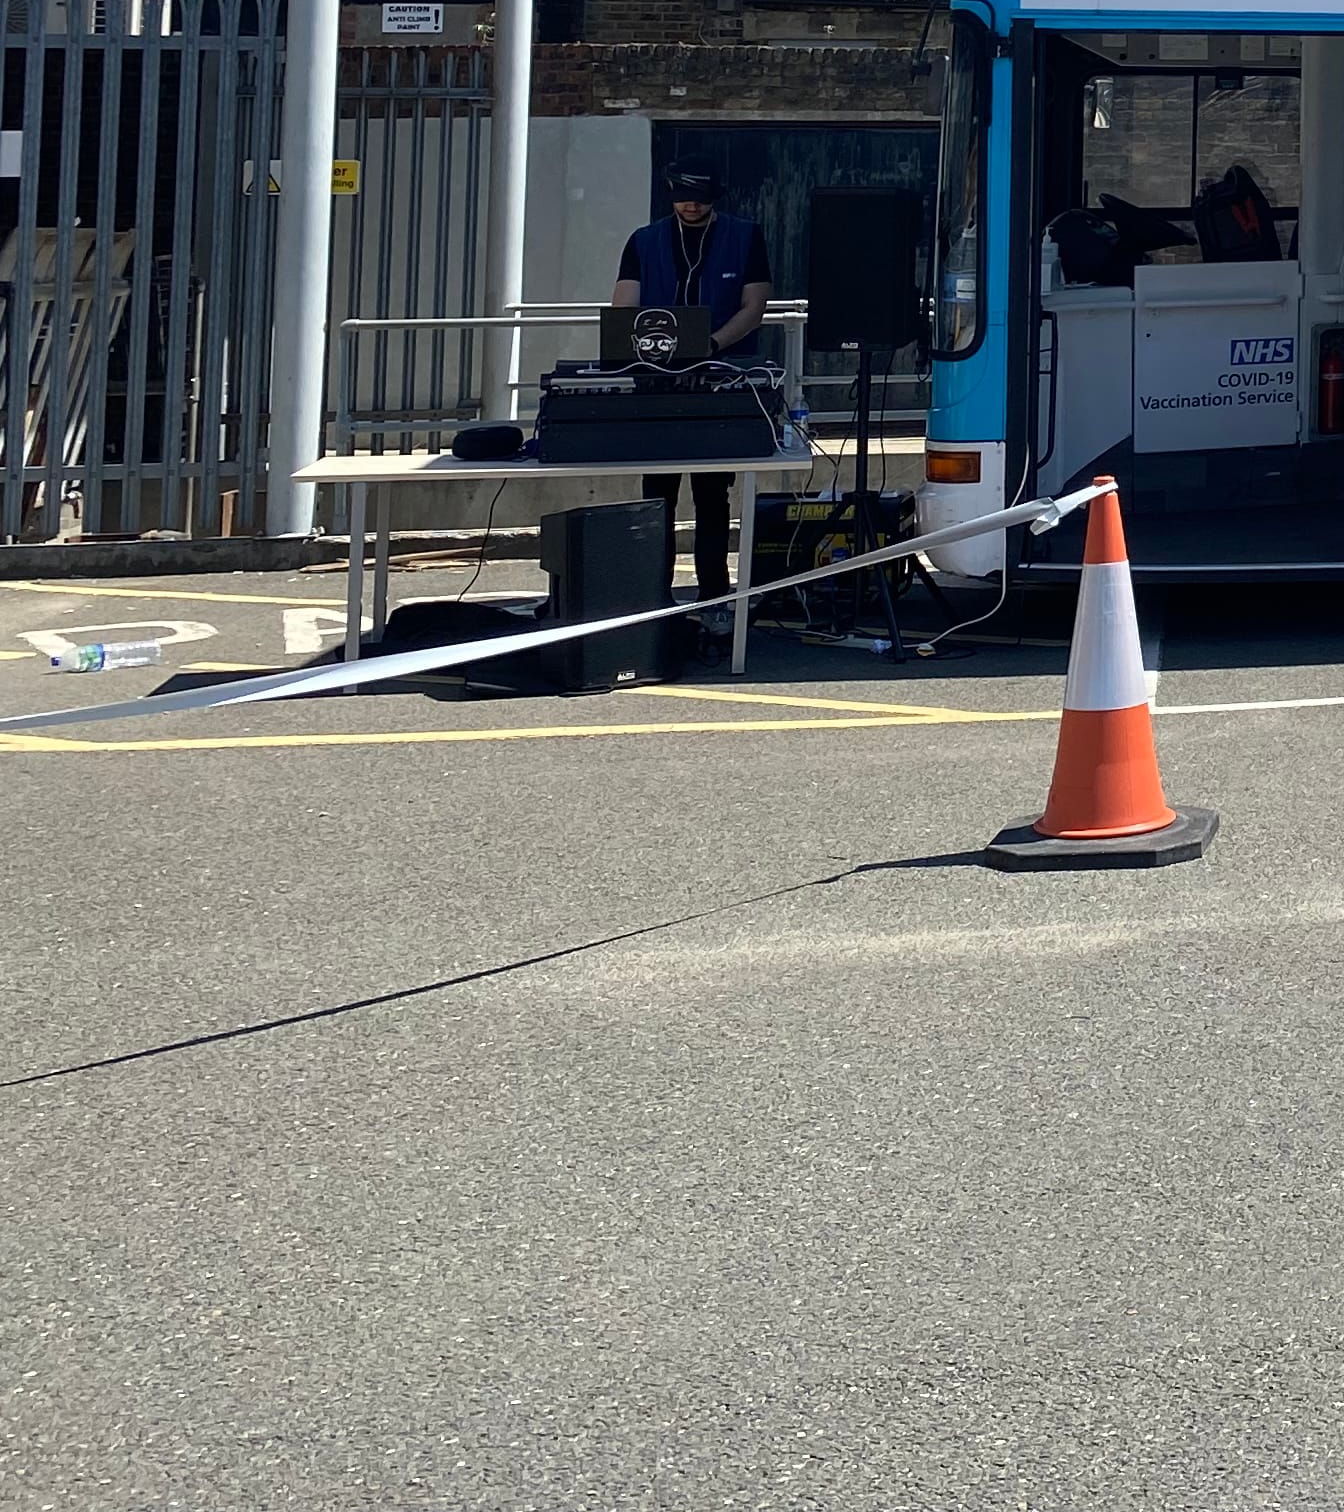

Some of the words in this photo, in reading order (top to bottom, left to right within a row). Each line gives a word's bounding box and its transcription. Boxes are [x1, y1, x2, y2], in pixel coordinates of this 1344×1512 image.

[1233, 340, 1291, 363] NHS
[1218, 371, 1294, 387] COVID-19
[1141, 393, 1232, 409] Vaccination
[1238, 389, 1293, 405] Service
